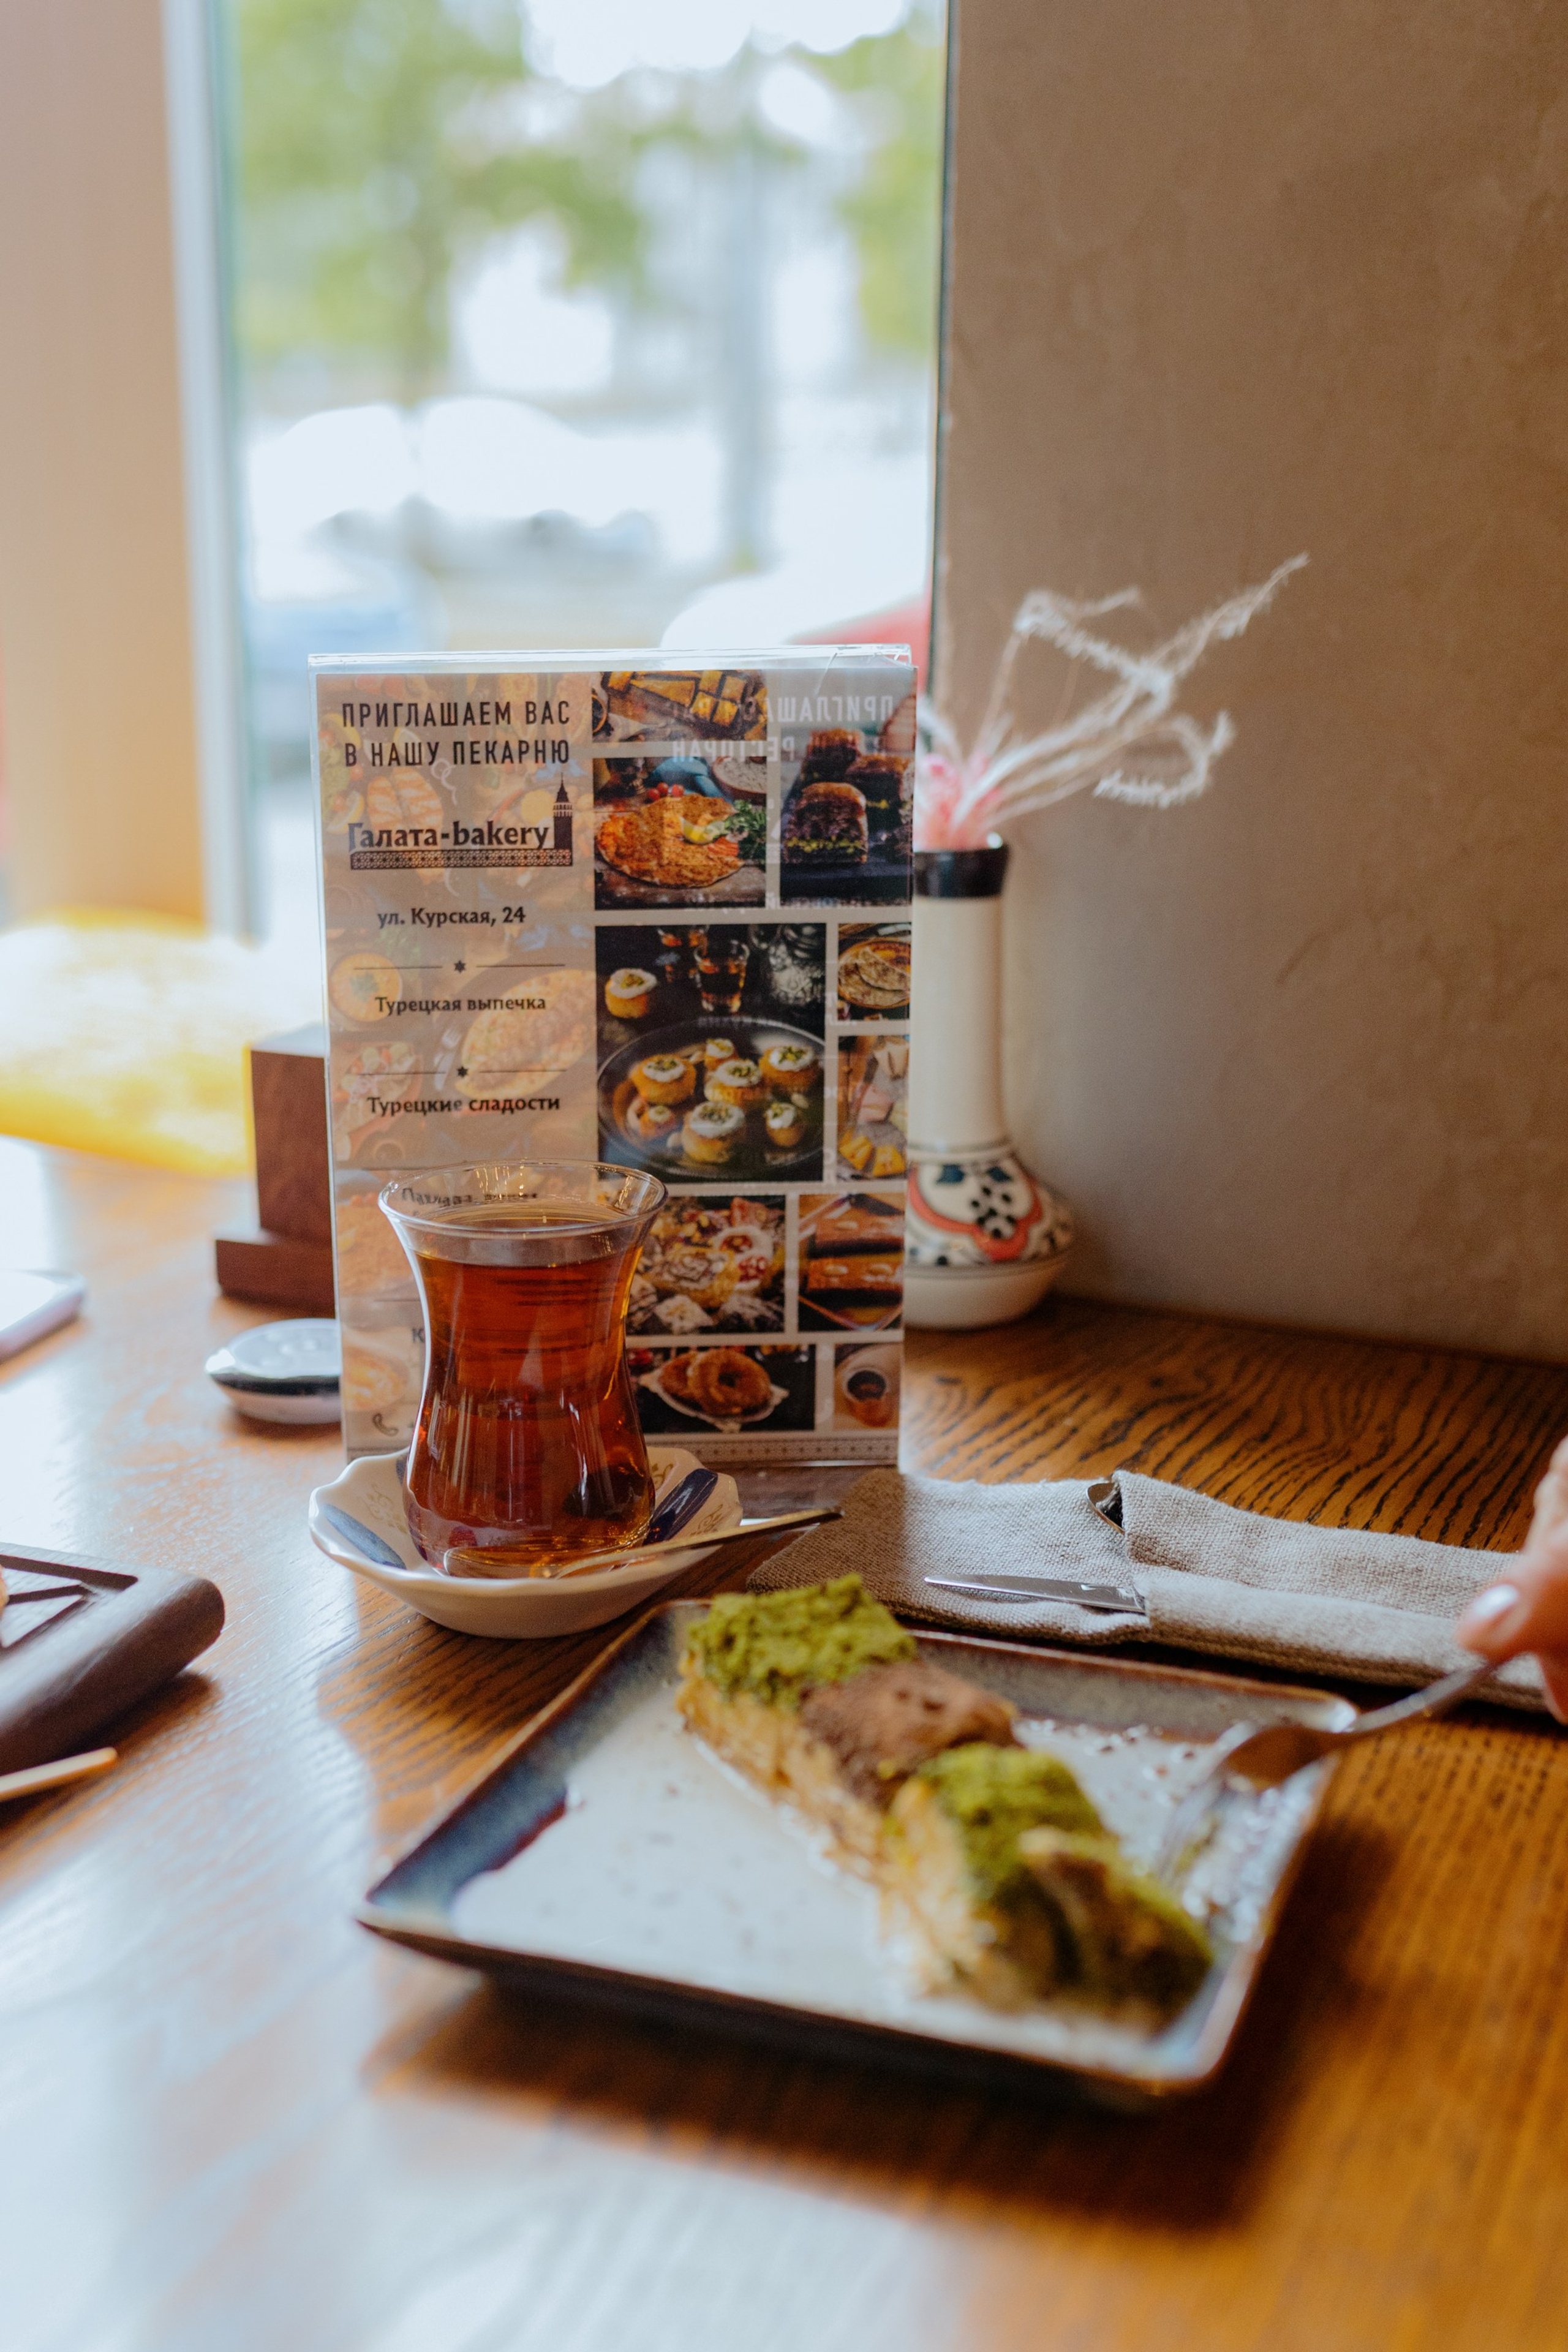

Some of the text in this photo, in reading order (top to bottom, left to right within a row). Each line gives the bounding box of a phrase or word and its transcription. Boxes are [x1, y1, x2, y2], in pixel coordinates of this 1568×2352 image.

[342, 700, 570, 728] ПРИГЛАШАЕМ ВАС
[344, 739, 570, 767] В НАШУ ПЕКАРНЮ
[347, 820, 550, 853] Галата-bakery
[377, 906, 526, 929] ул. Курская, 24
[375, 997, 546, 1017] Турецкая выпечка
[368, 1096, 560, 1117] Турецкие сладости
